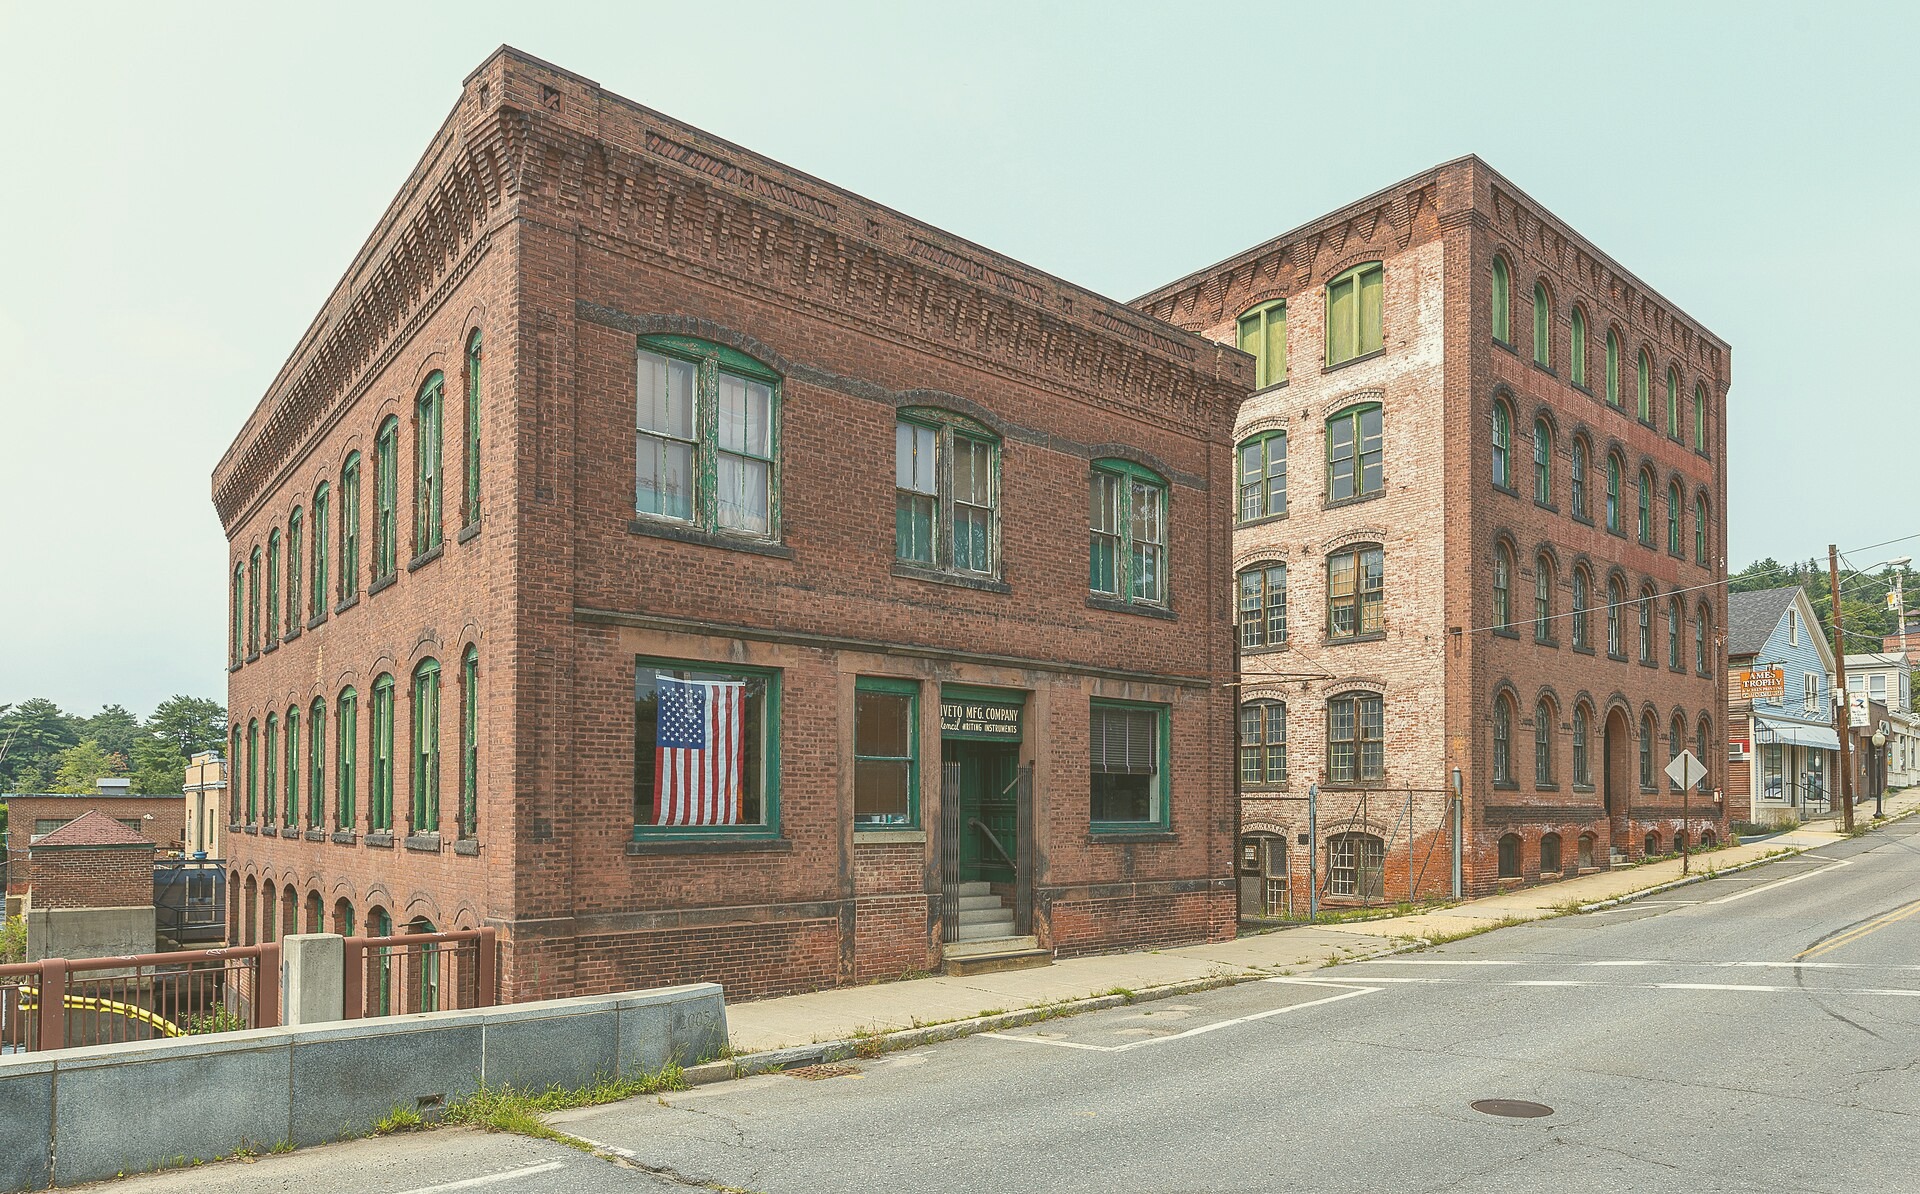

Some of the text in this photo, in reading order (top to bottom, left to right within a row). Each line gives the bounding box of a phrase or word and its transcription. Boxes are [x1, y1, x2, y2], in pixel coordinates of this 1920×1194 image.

[1743, 678, 1782, 687] TROPHY
[940, 704, 1018, 721] IVETO MFG. COMPANY
[962, 722, 982, 732] WRITING
[984, 723, 1018, 733] INSTRUMENTS
